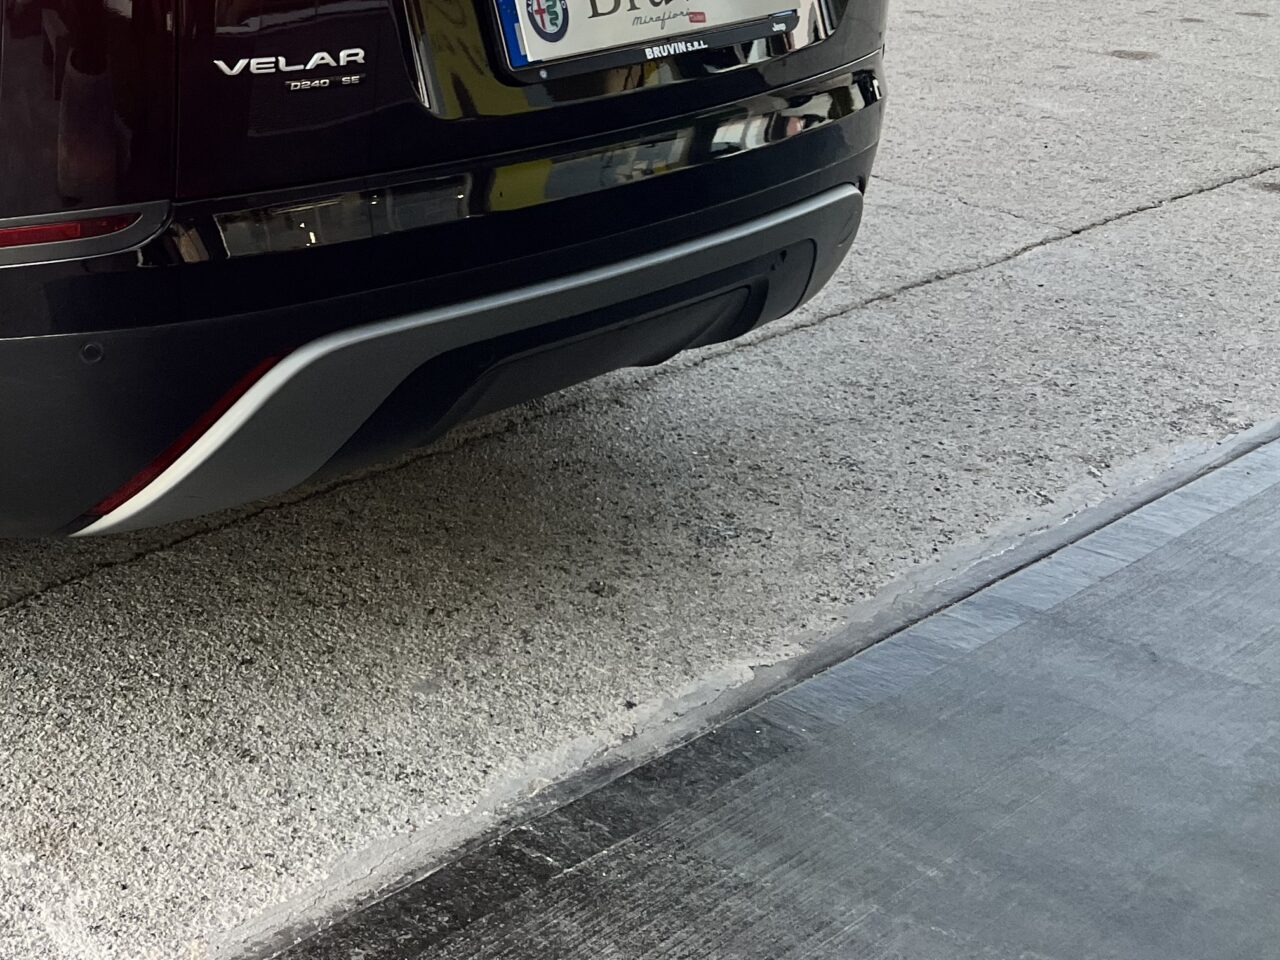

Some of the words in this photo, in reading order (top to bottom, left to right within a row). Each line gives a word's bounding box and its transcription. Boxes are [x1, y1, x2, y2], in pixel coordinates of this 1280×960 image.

[644, 41, 687, 60] BRUVIN
[212, 48, 366, 76] VELAR
[290, 78, 330, 91] D240
[341, 75, 360, 85] SE
